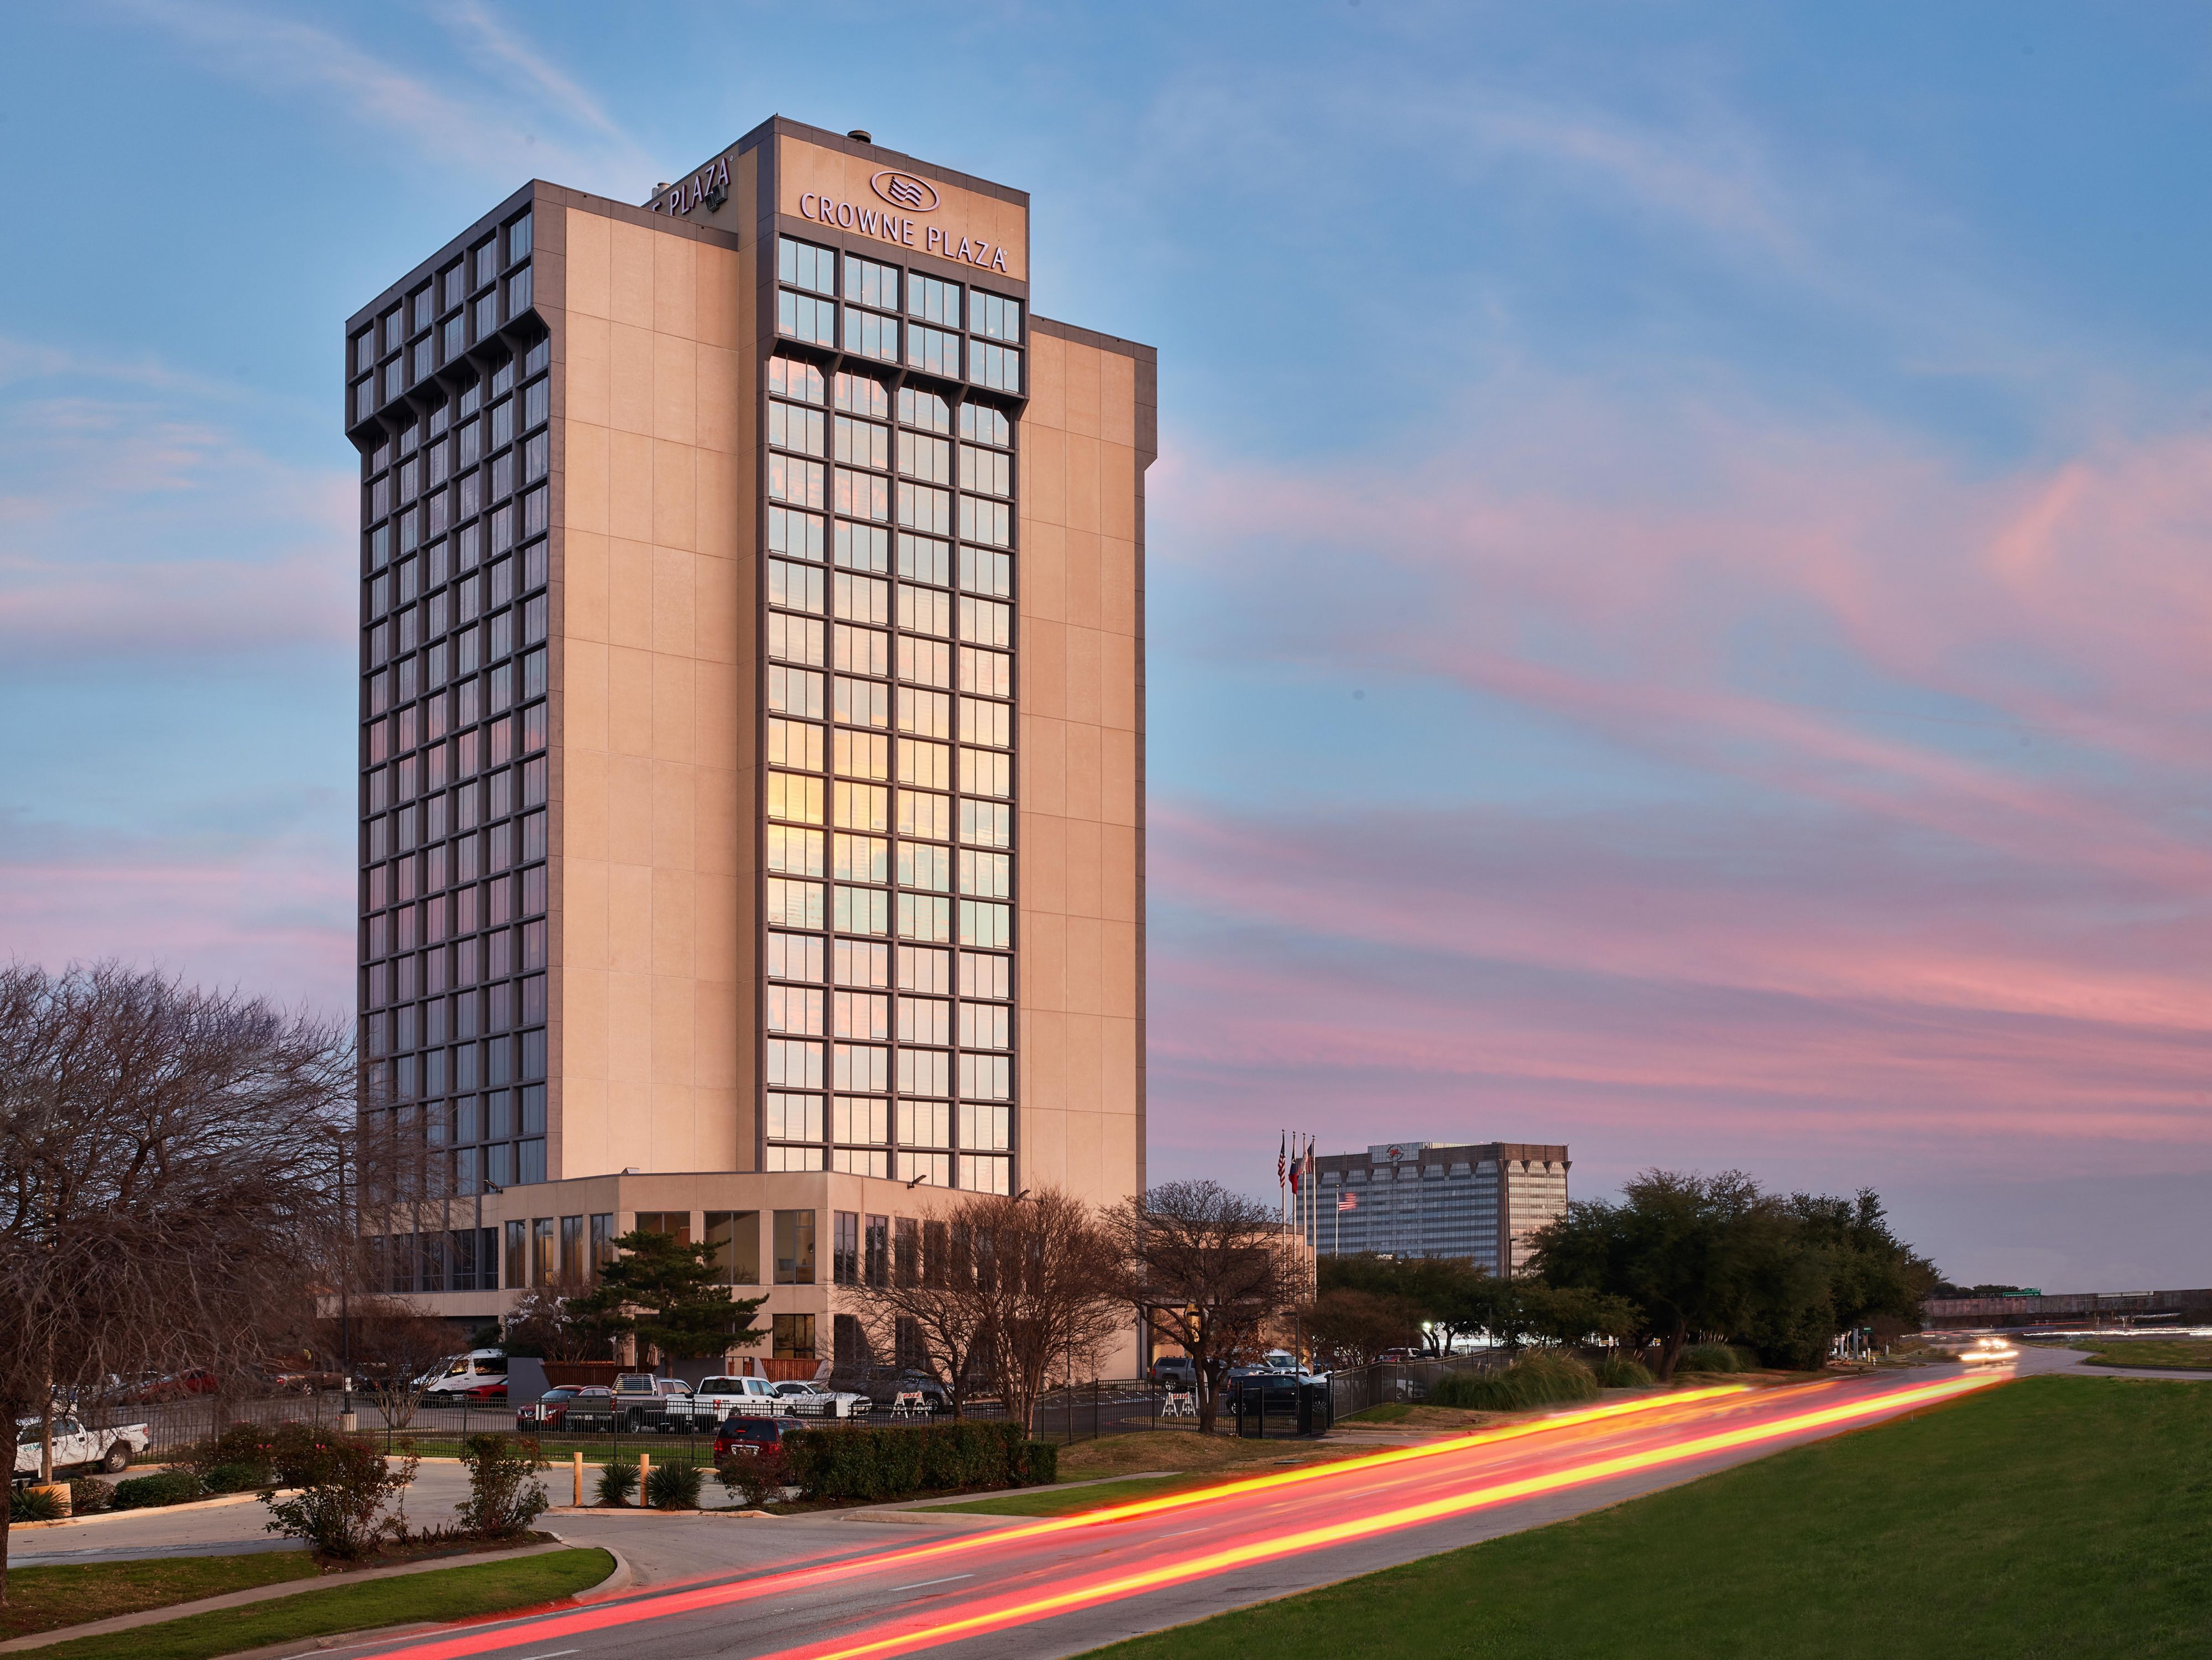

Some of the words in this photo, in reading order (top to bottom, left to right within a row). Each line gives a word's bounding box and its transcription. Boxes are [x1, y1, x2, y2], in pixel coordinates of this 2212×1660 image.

[670, 158, 731, 216] PLAZA
[801, 192, 915, 246] CROWNE
[927, 226, 1007, 272] PLAZA
